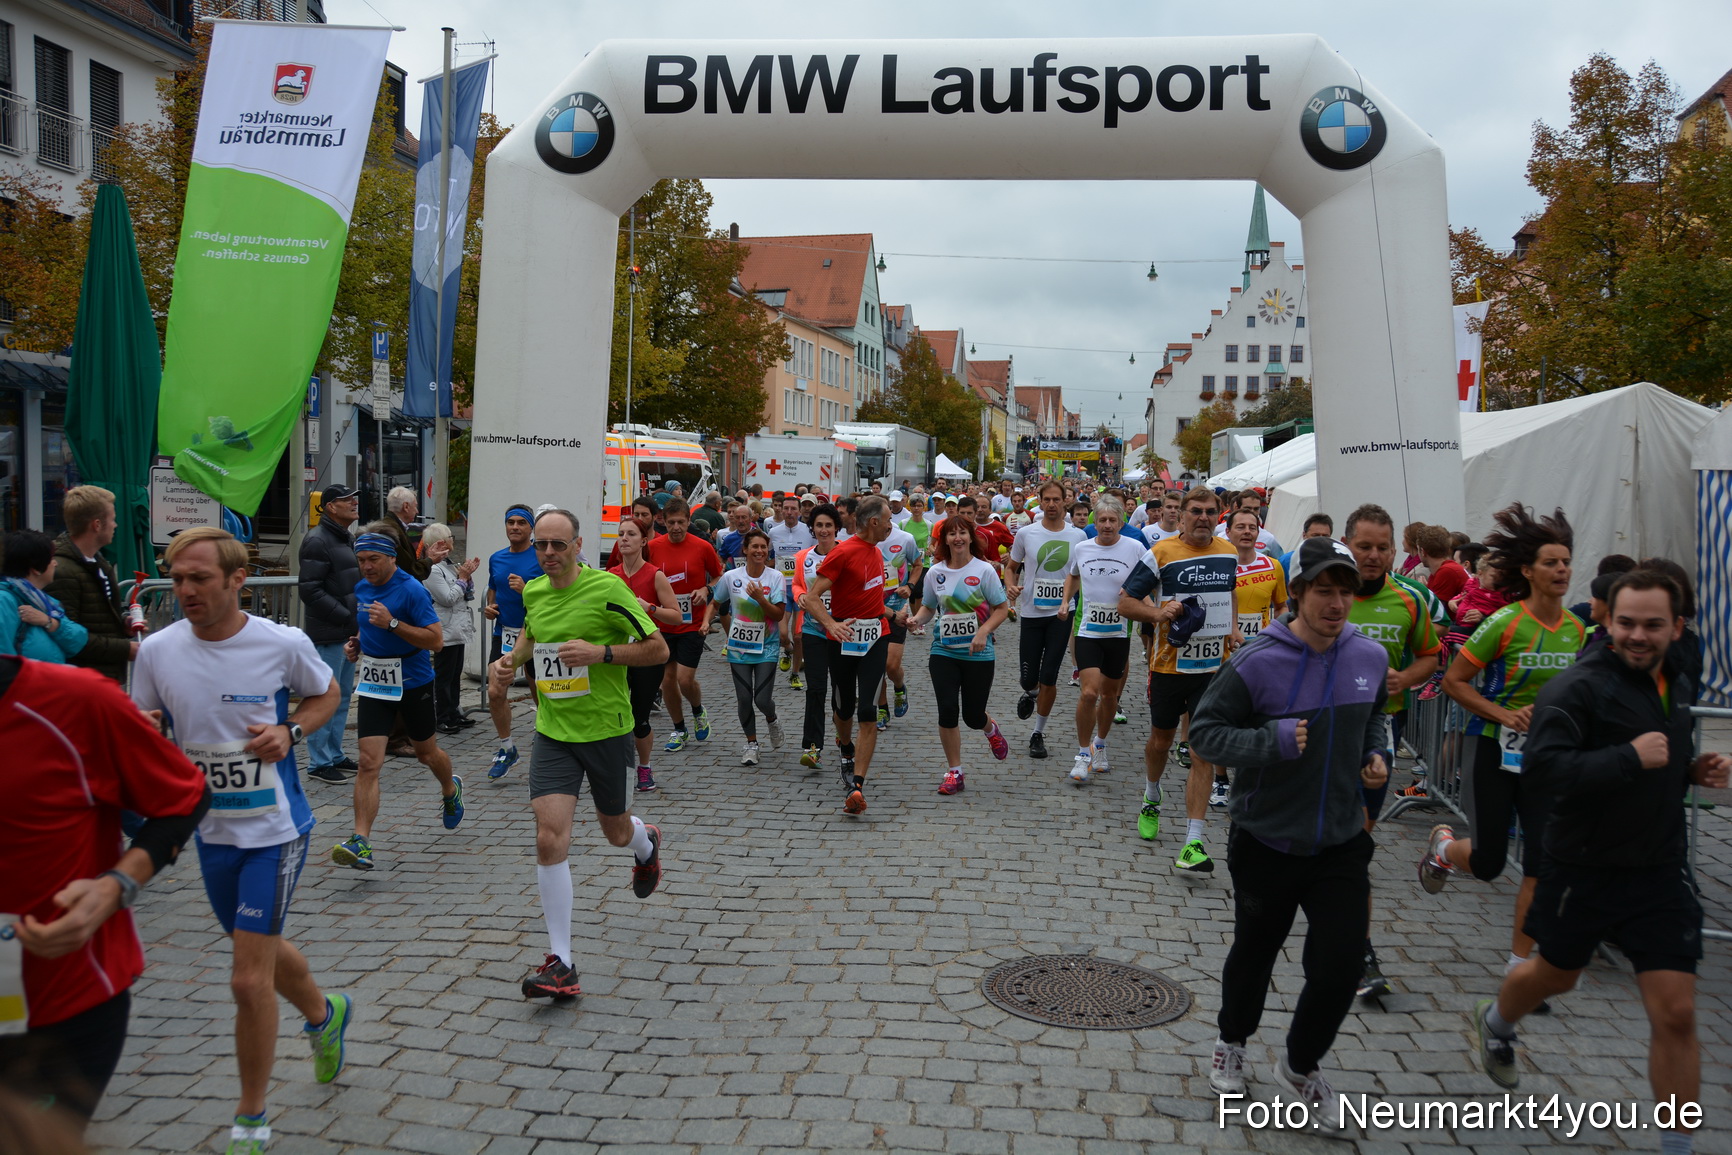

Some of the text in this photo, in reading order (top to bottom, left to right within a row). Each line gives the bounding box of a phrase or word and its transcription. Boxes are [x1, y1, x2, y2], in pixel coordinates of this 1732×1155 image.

[644, 52, 1271, 128] BMW Laufsport
[546, 94, 608, 120] BMW
[1308, 88, 1378, 115] BMW
[376, 330, 385, 355] P
[310, 382, 318, 412] P
[473, 433, 581, 448] www.bmw-laufsport.de
[1340, 439, 1459, 454] www.bmw-laufsport.de
[162, 496, 211, 504] Kreuzung über
[165, 516, 208, 524] Kaserngasse
[1188, 571, 1230, 582] Fischer
[1236, 573, 1277, 588] AX BÖGL
[1037, 586, 1064, 598] 3008
[1090, 610, 1120, 623] 3043
[732, 626, 761, 642] 2637
[944, 621, 975, 636] 2456
[1182, 642, 1220, 658] 2163
[363, 666, 396, 685] 2641
[214, 795, 250, 807] Stefan
